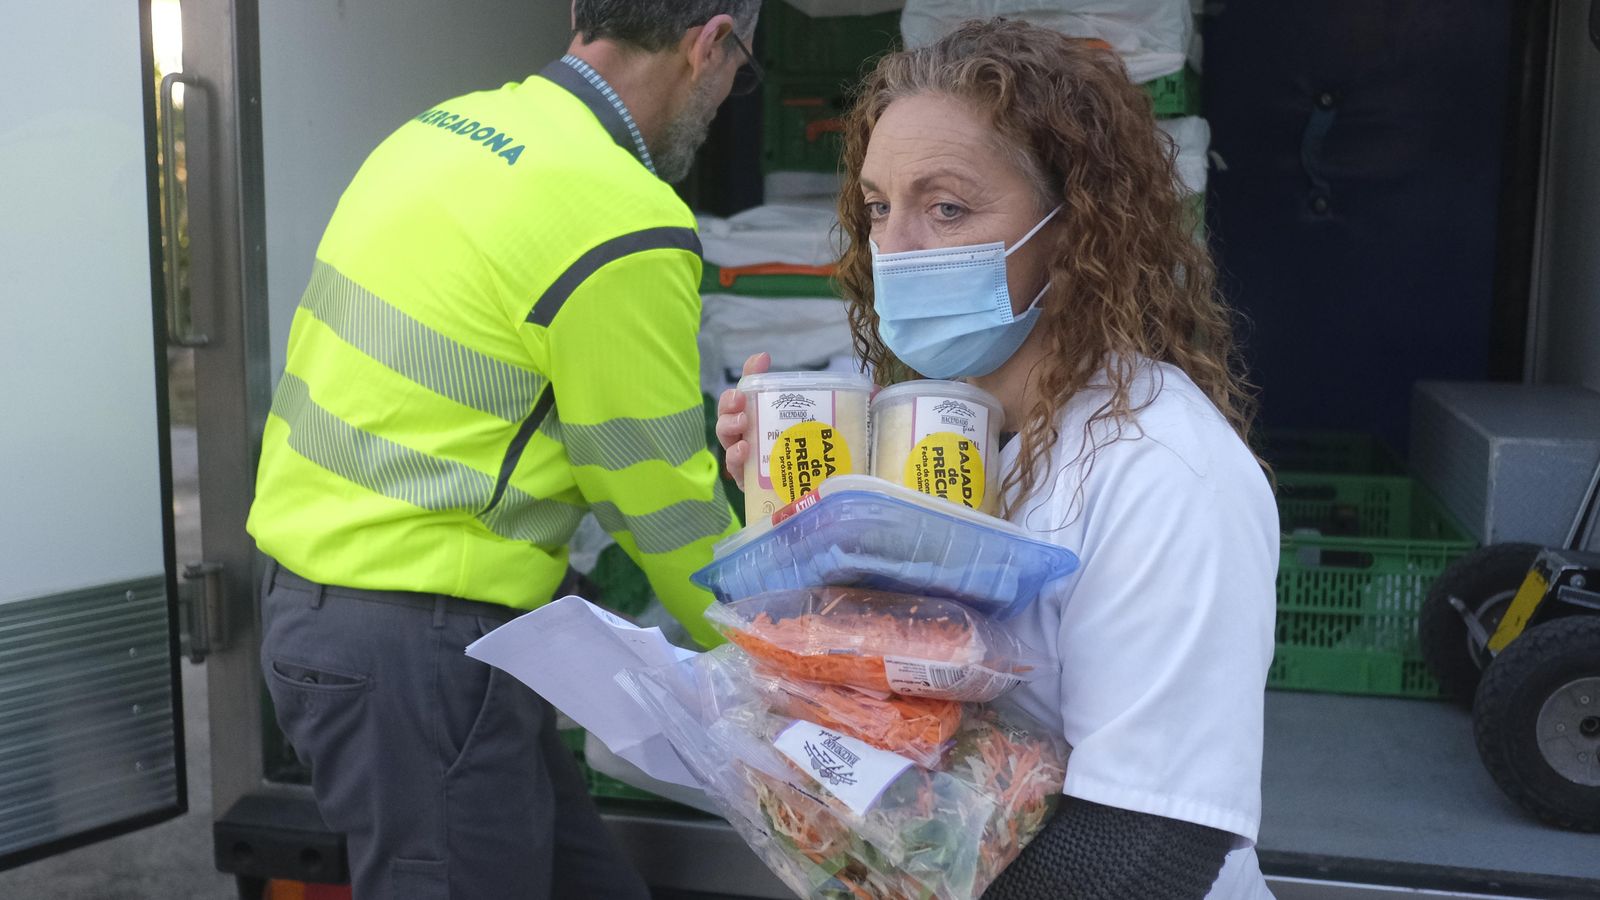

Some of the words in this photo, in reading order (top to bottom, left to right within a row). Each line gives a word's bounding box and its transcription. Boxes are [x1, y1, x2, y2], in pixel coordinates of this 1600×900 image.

[767, 429, 784, 441] PIÑ
[821, 429, 836, 478] BAJA
[779, 456, 787, 487] próxima
[787, 461, 794, 471] de
[811, 458, 823, 477] de
[923, 468, 930, 478] de
[948, 468, 959, 485] de
[823, 738, 858, 766] HACENDADO
